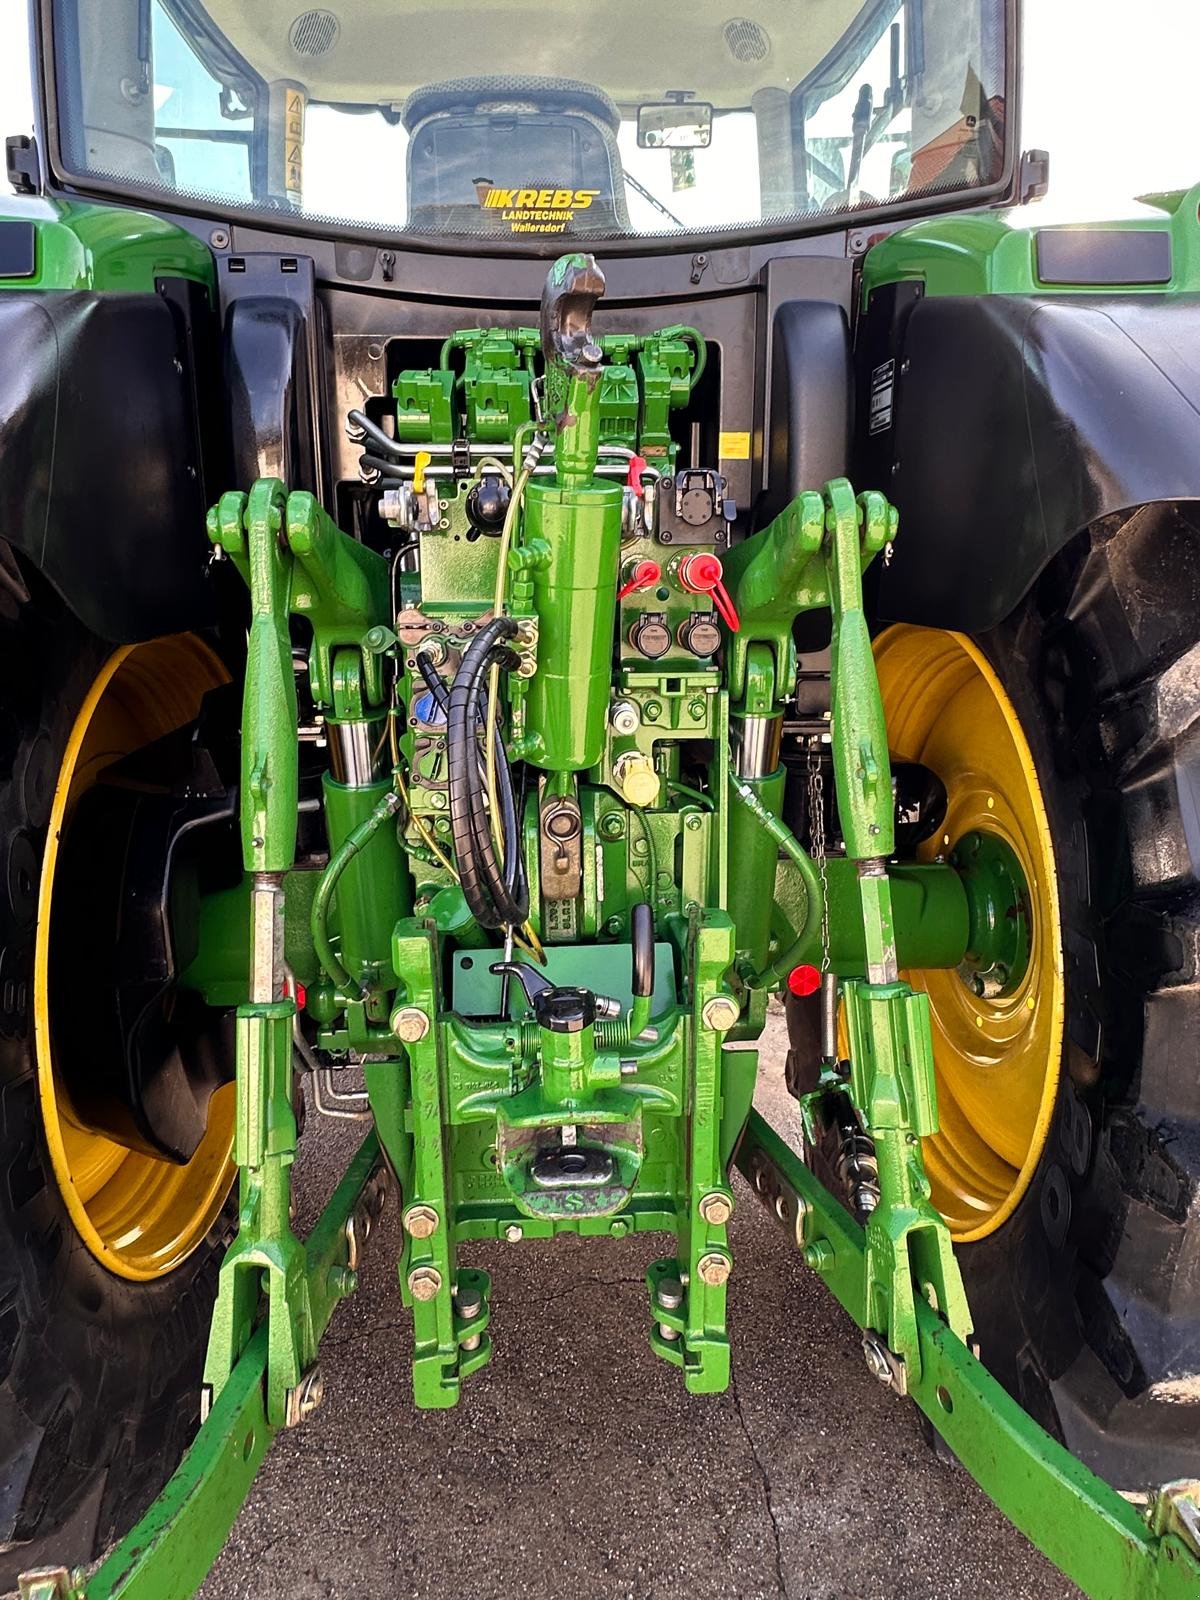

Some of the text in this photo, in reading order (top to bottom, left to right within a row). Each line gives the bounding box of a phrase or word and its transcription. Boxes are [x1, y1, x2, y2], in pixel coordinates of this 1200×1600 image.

[484, 189, 600, 208] KREBS
[502, 211, 574, 220] LANDTECHNIK
[511, 223, 565, 232] Wallersdorf
